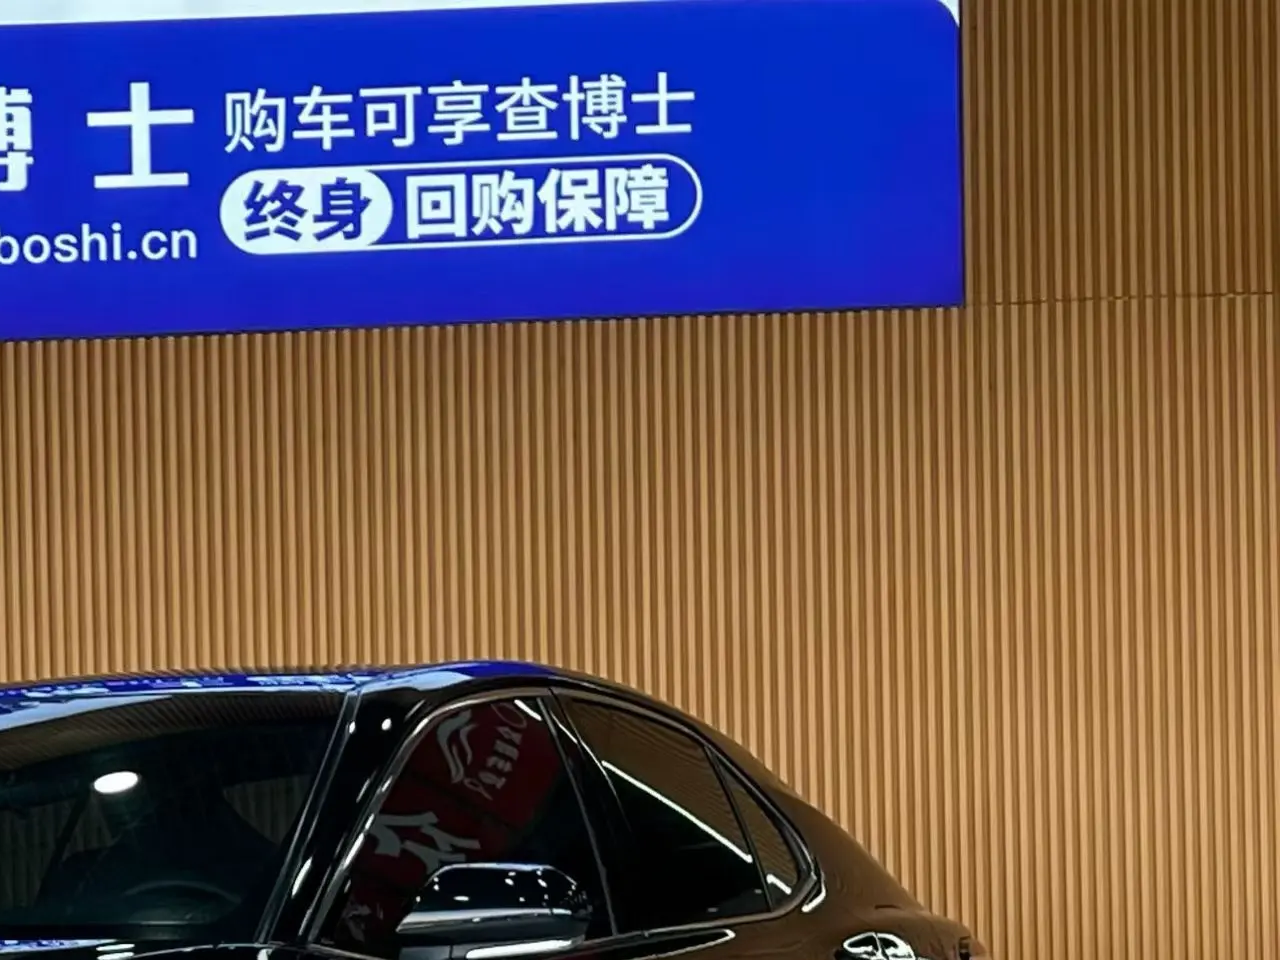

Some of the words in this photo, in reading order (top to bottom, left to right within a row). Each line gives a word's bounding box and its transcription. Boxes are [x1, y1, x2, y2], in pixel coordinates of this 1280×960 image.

[225, 71, 695, 154] 购车可享查博士
[244, 177, 374, 243] 终身
[405, 163, 671, 240] 回购保障
